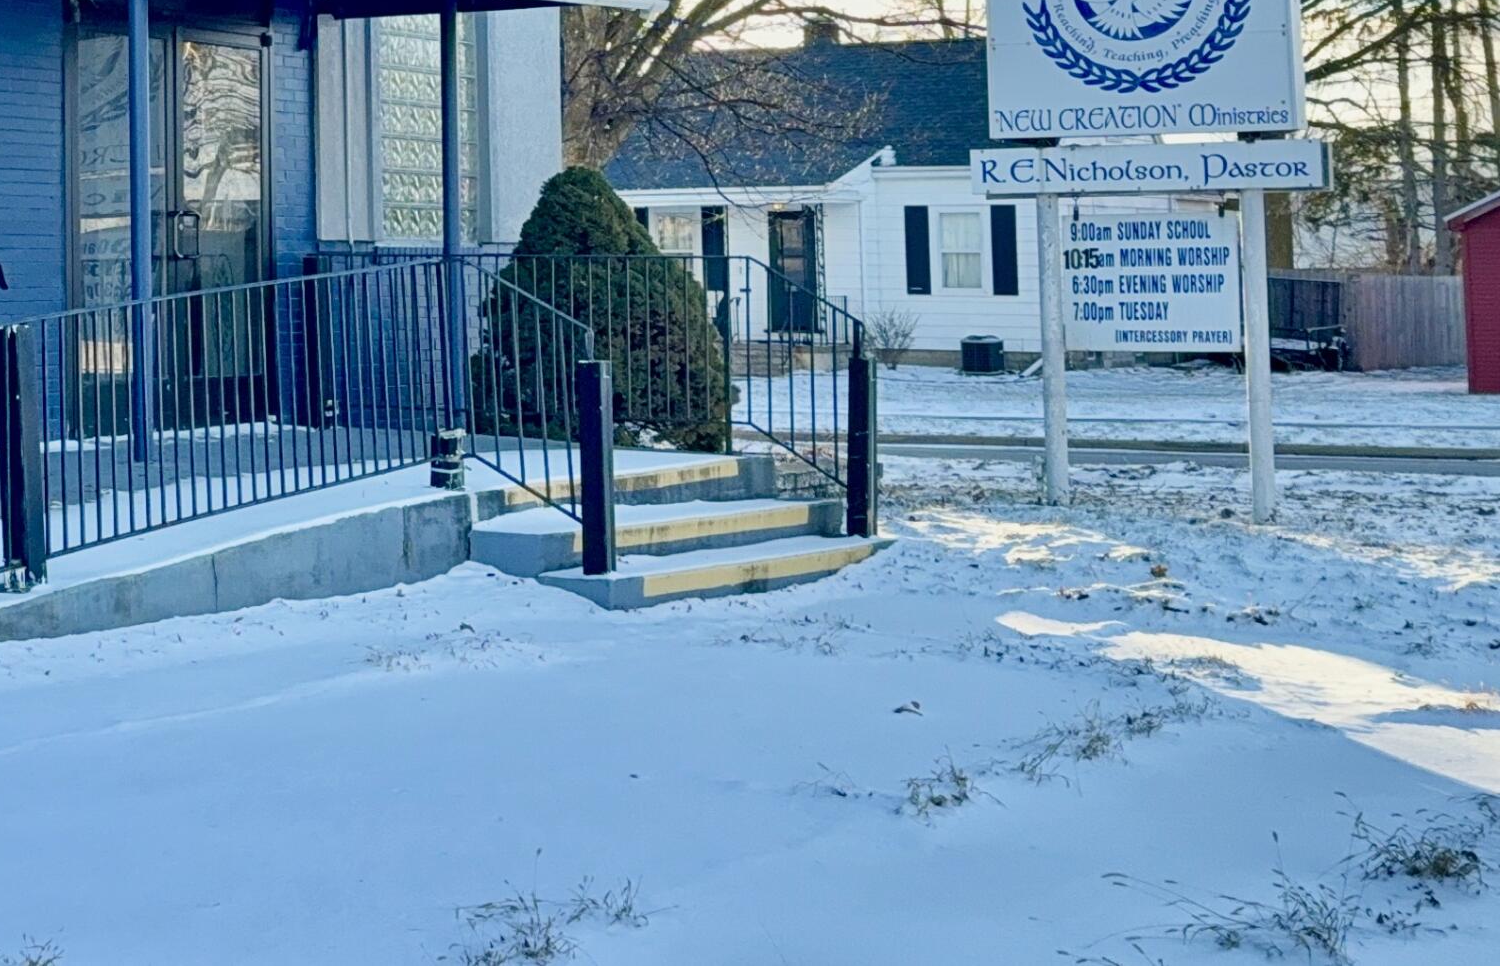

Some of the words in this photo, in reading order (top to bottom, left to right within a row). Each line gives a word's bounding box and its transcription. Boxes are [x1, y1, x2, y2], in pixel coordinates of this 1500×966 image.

[994, 109, 1051, 133] NEW
[1059, 104, 1177, 131] CREATION
[1070, 222, 1112, 242] 9:00am
[1117, 220, 1162, 241] SUNDAY
[1166, 219, 1211, 240] SCHOOL
[1120, 247, 1172, 267] MORNING
[1177, 246, 1230, 267] WORSHIP
[1072, 275, 1114, 296] 6:30pm
[1118, 274, 1167, 294] EVENING
[1171, 273, 1225, 294] WORSHIP
[1073, 301, 1114, 323] 7:00pm
[1118, 301, 1169, 321] TUESDAY
